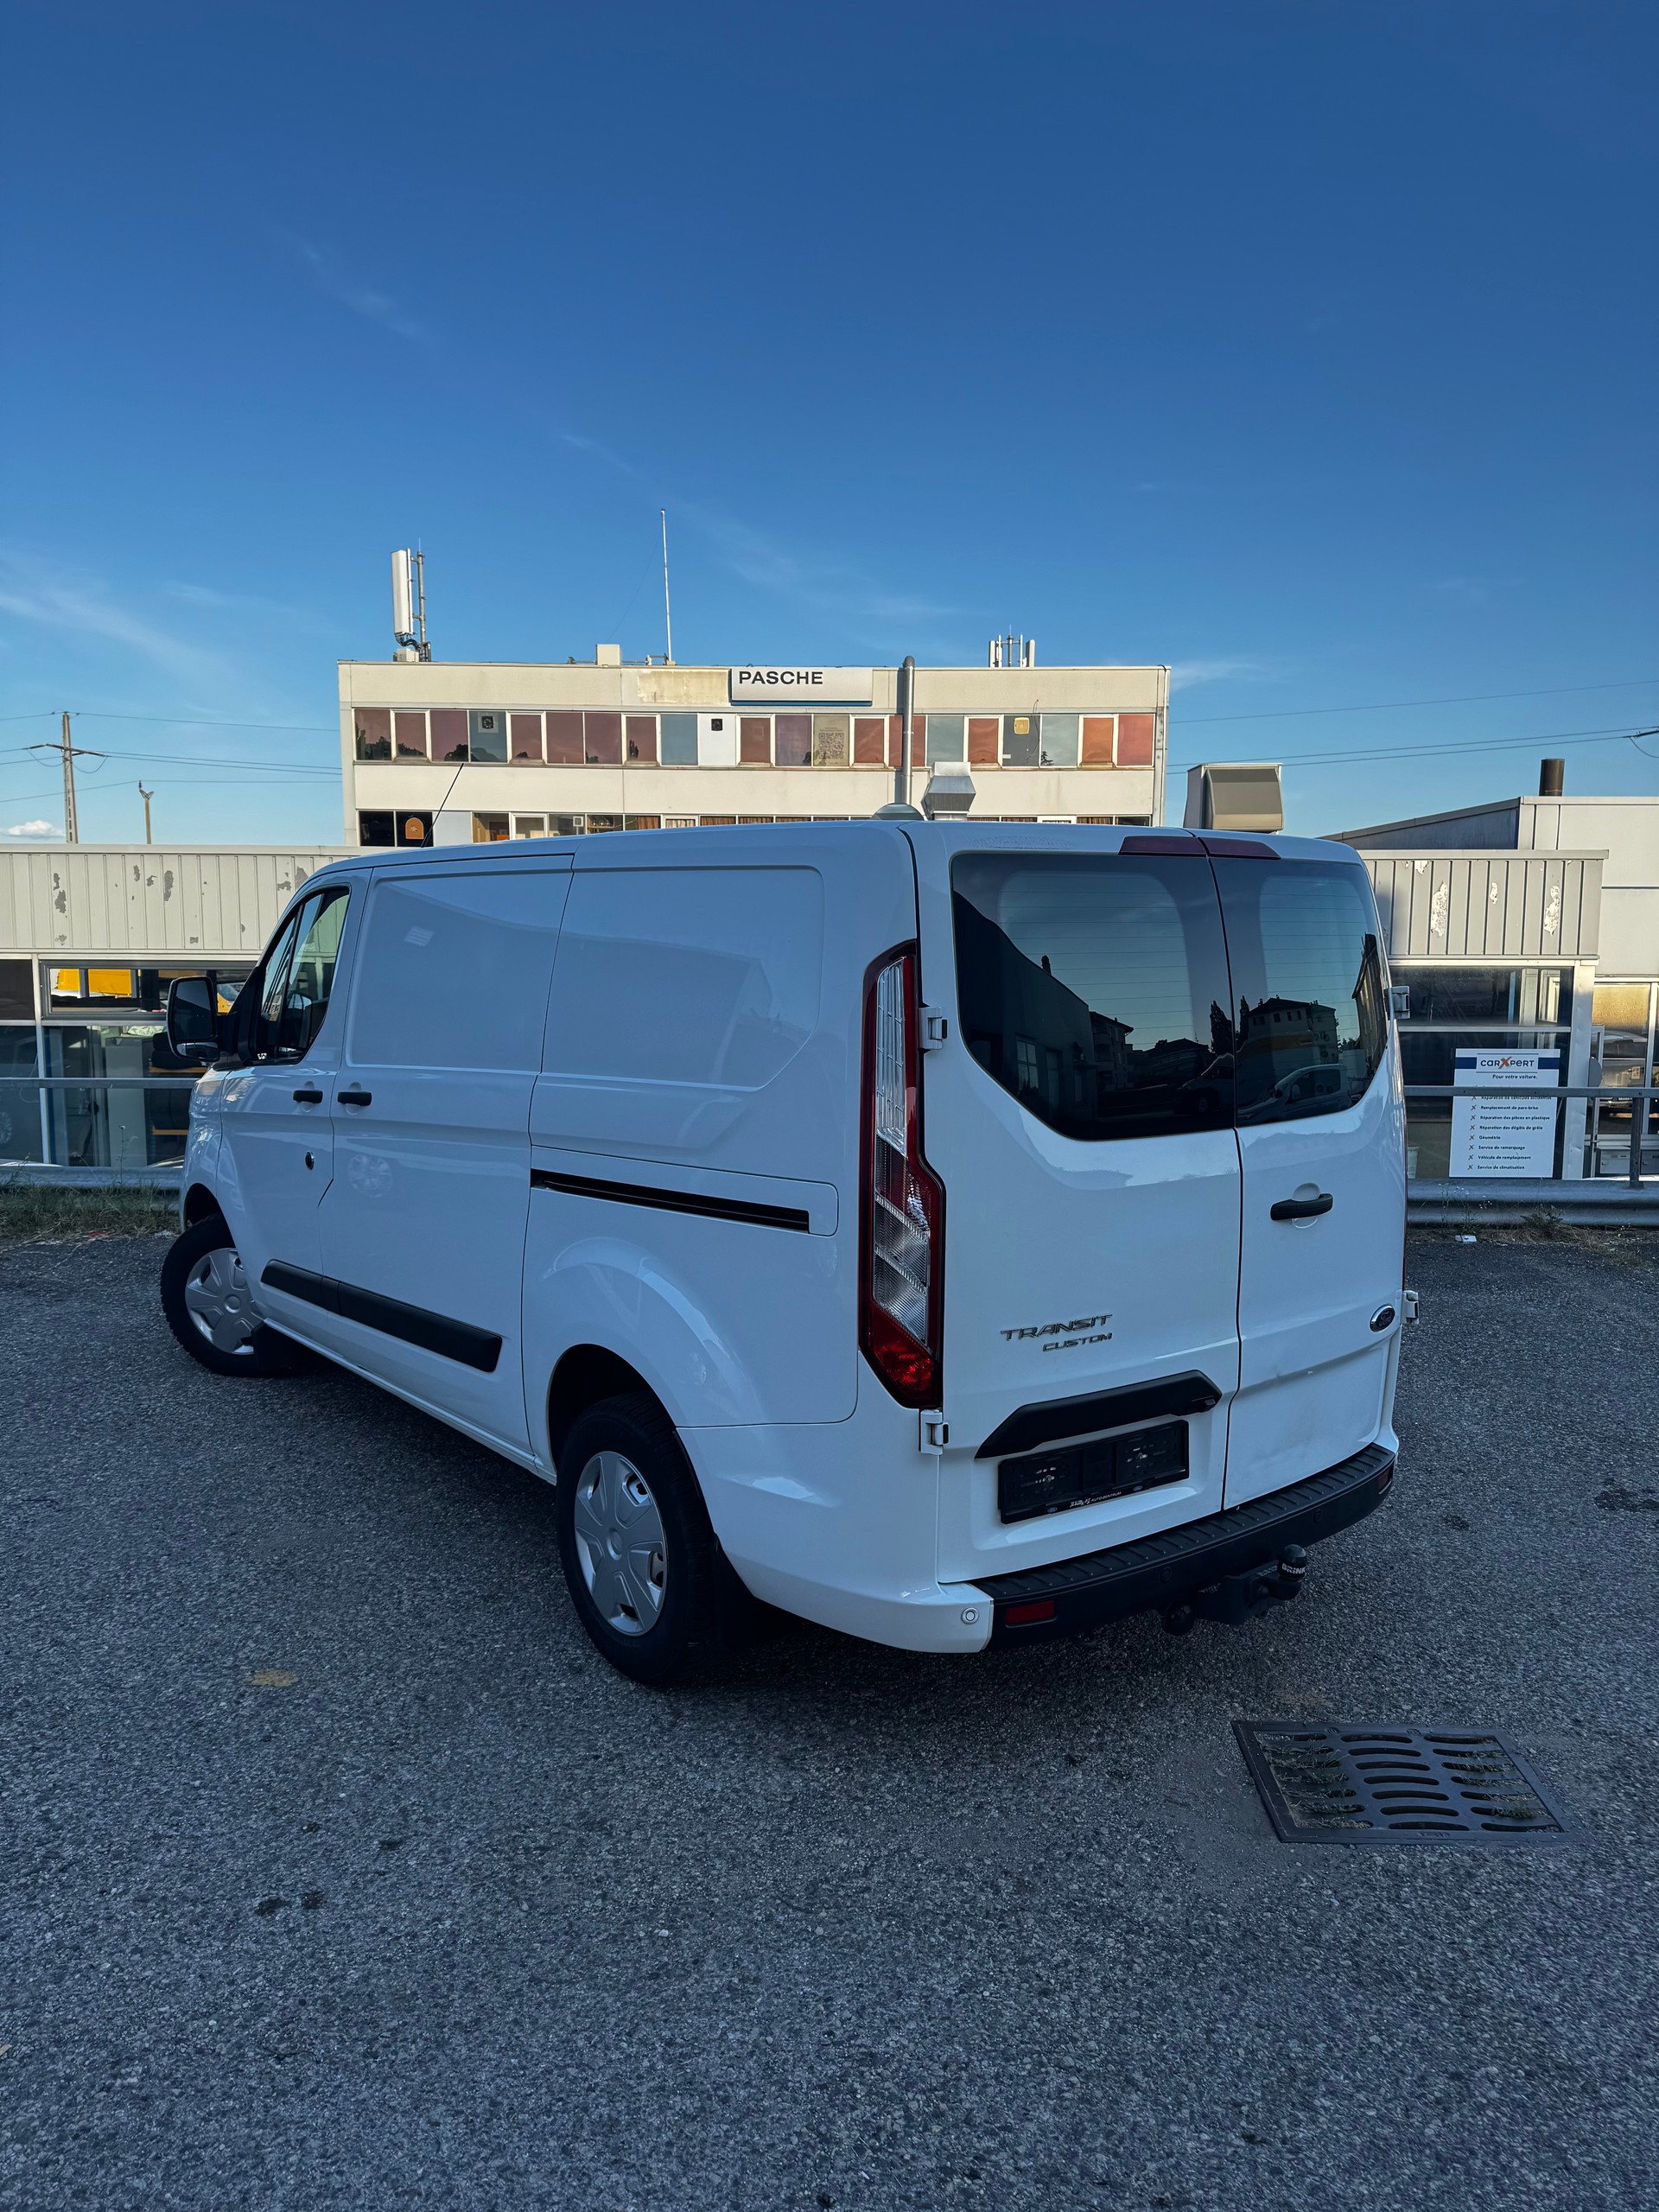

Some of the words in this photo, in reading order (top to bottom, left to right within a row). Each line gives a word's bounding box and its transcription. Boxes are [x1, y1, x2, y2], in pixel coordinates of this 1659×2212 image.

[739, 671, 823, 684] PASCHE
[1000, 1313, 1113, 1341] TRANSIT
[1042, 1332, 1113, 1352] CUSTOM
